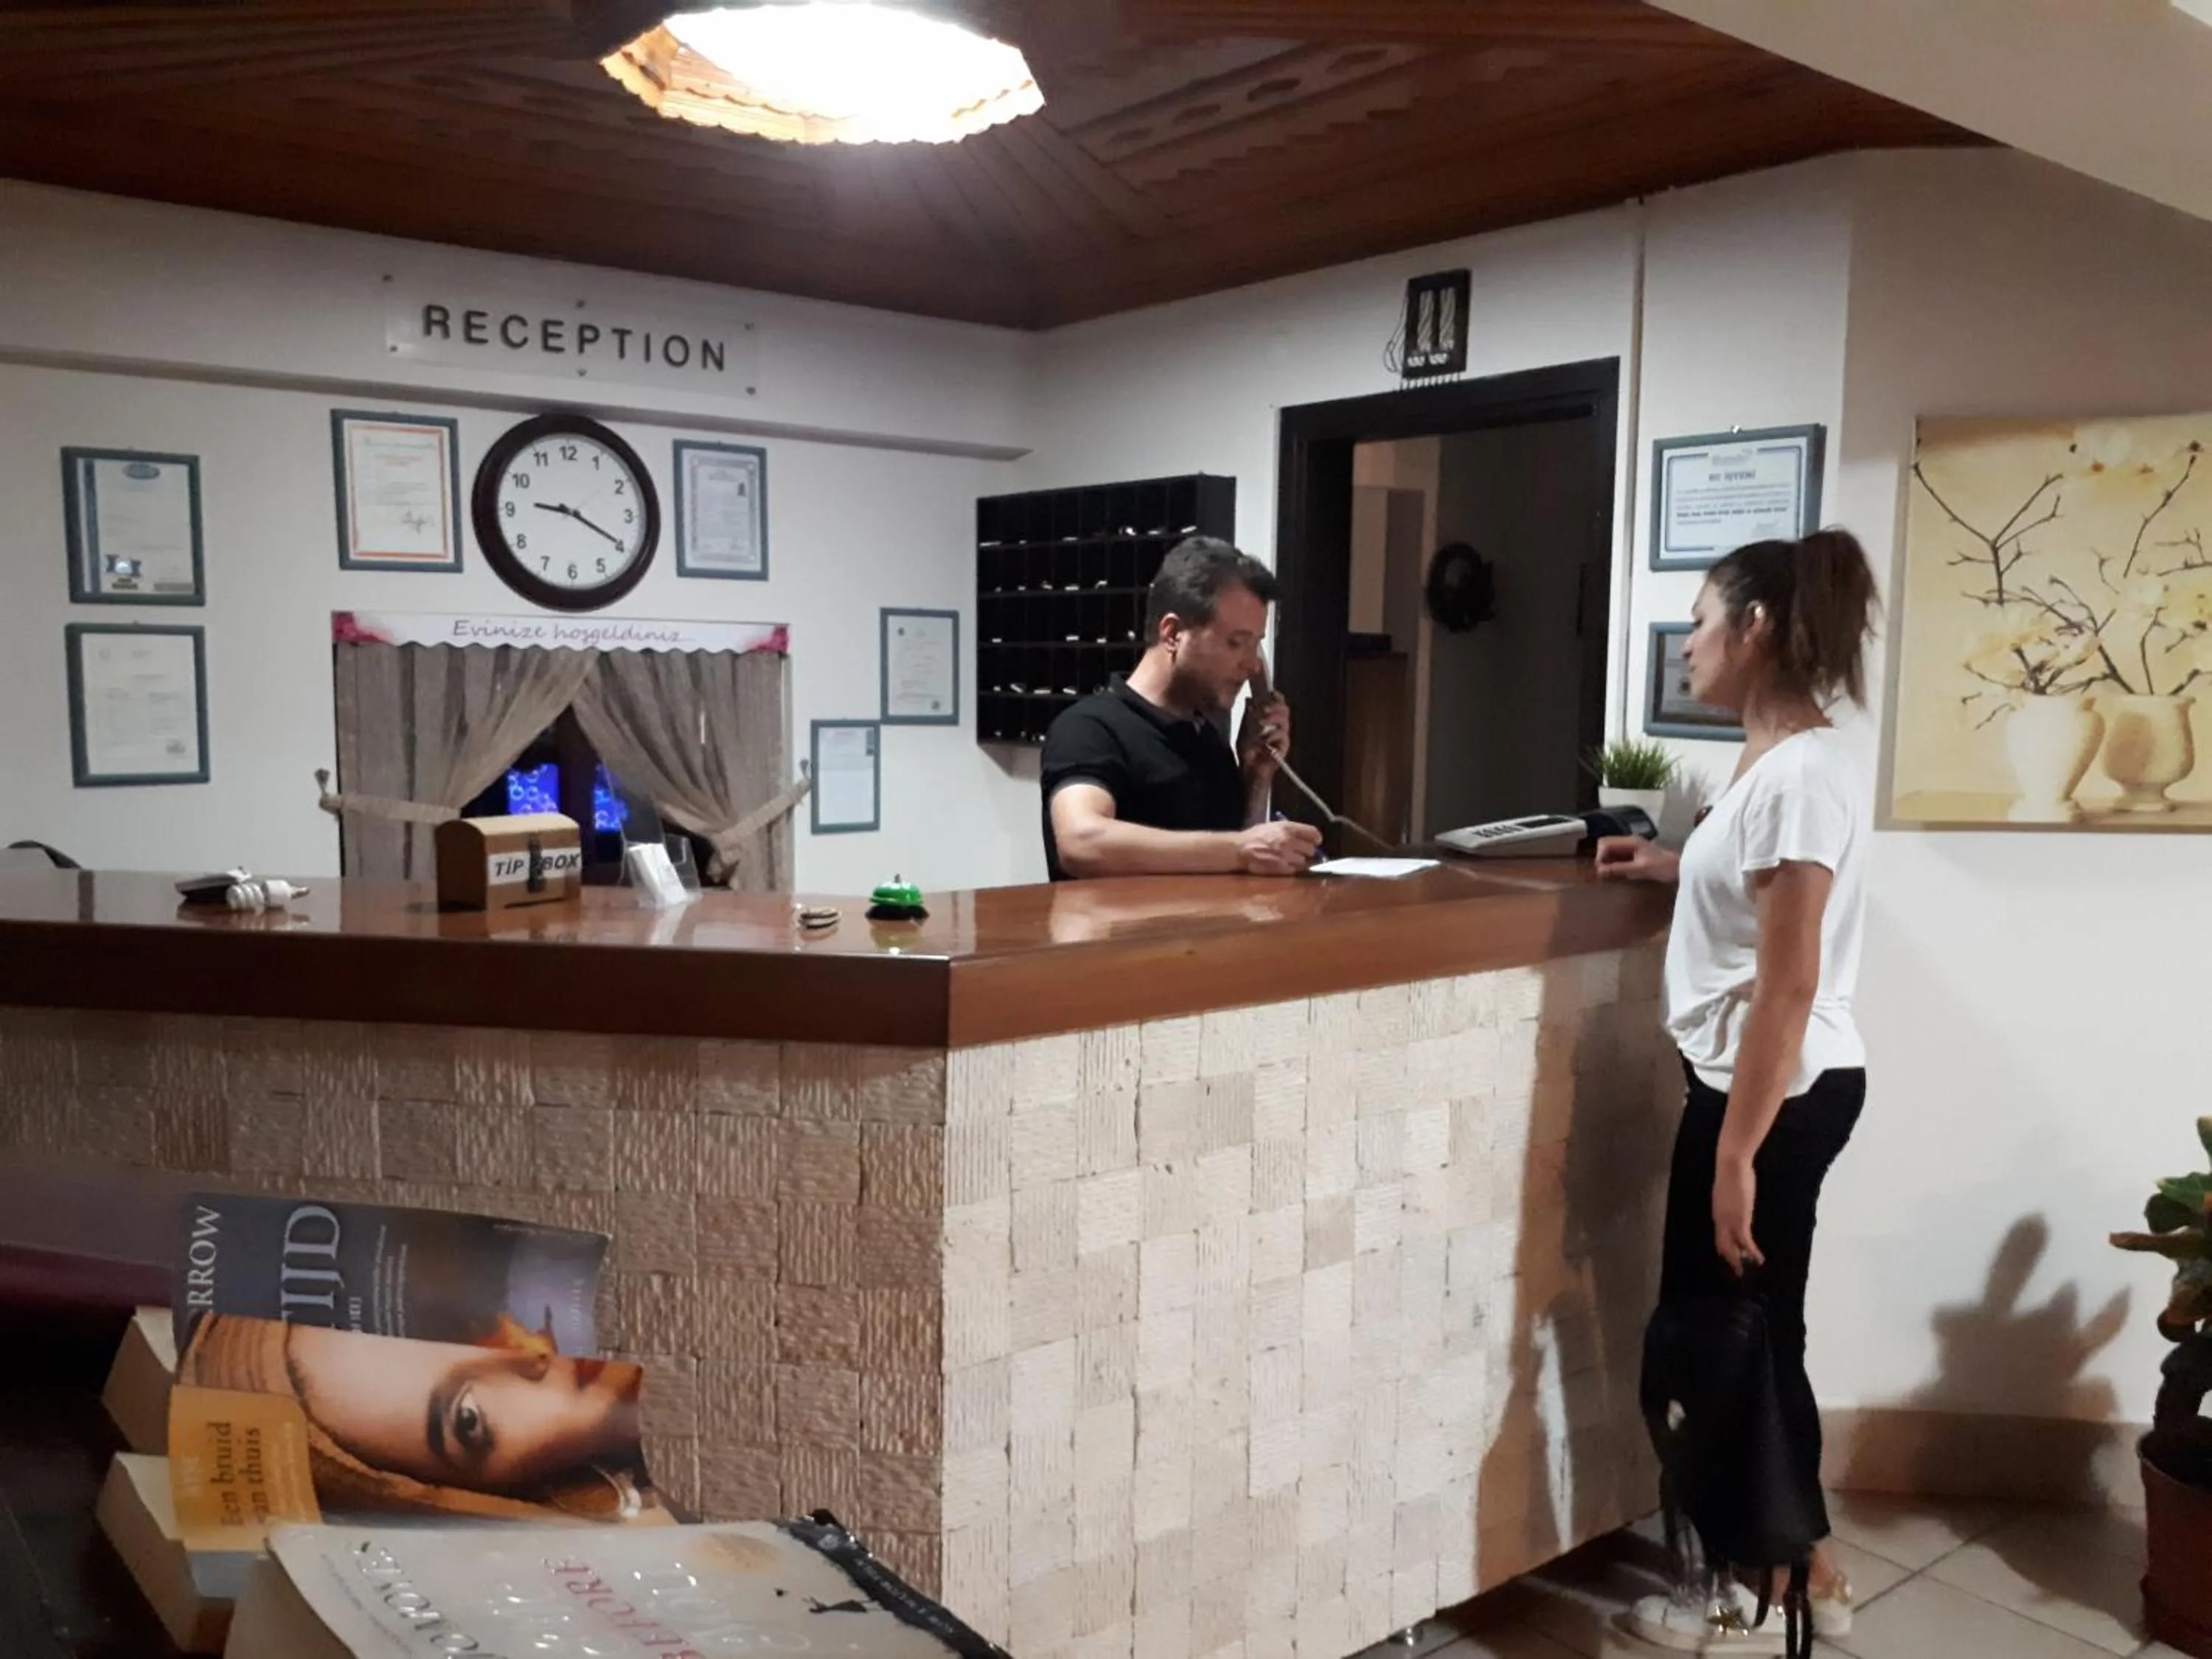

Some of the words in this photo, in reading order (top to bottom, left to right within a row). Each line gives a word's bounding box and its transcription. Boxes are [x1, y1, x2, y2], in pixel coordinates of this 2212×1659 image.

[422, 305, 725, 371] RECEPTION
[534, 451, 549, 467] 11
[560, 445, 577, 461] 12
[593, 455, 600, 470] 1
[513, 473, 530, 489] 10
[614, 479, 625, 495] 2
[505, 501, 515, 518] 9
[625, 509, 633, 524] 3
[518, 534, 526, 549] 8
[541, 556, 550, 571] 7
[597, 557, 606, 573] 5
[568, 564, 578, 580] 6
[453, 619, 547, 637] Evinize
[206, 1422, 234, 1484] bruid
[238, 1427, 263, 1484] thuis
